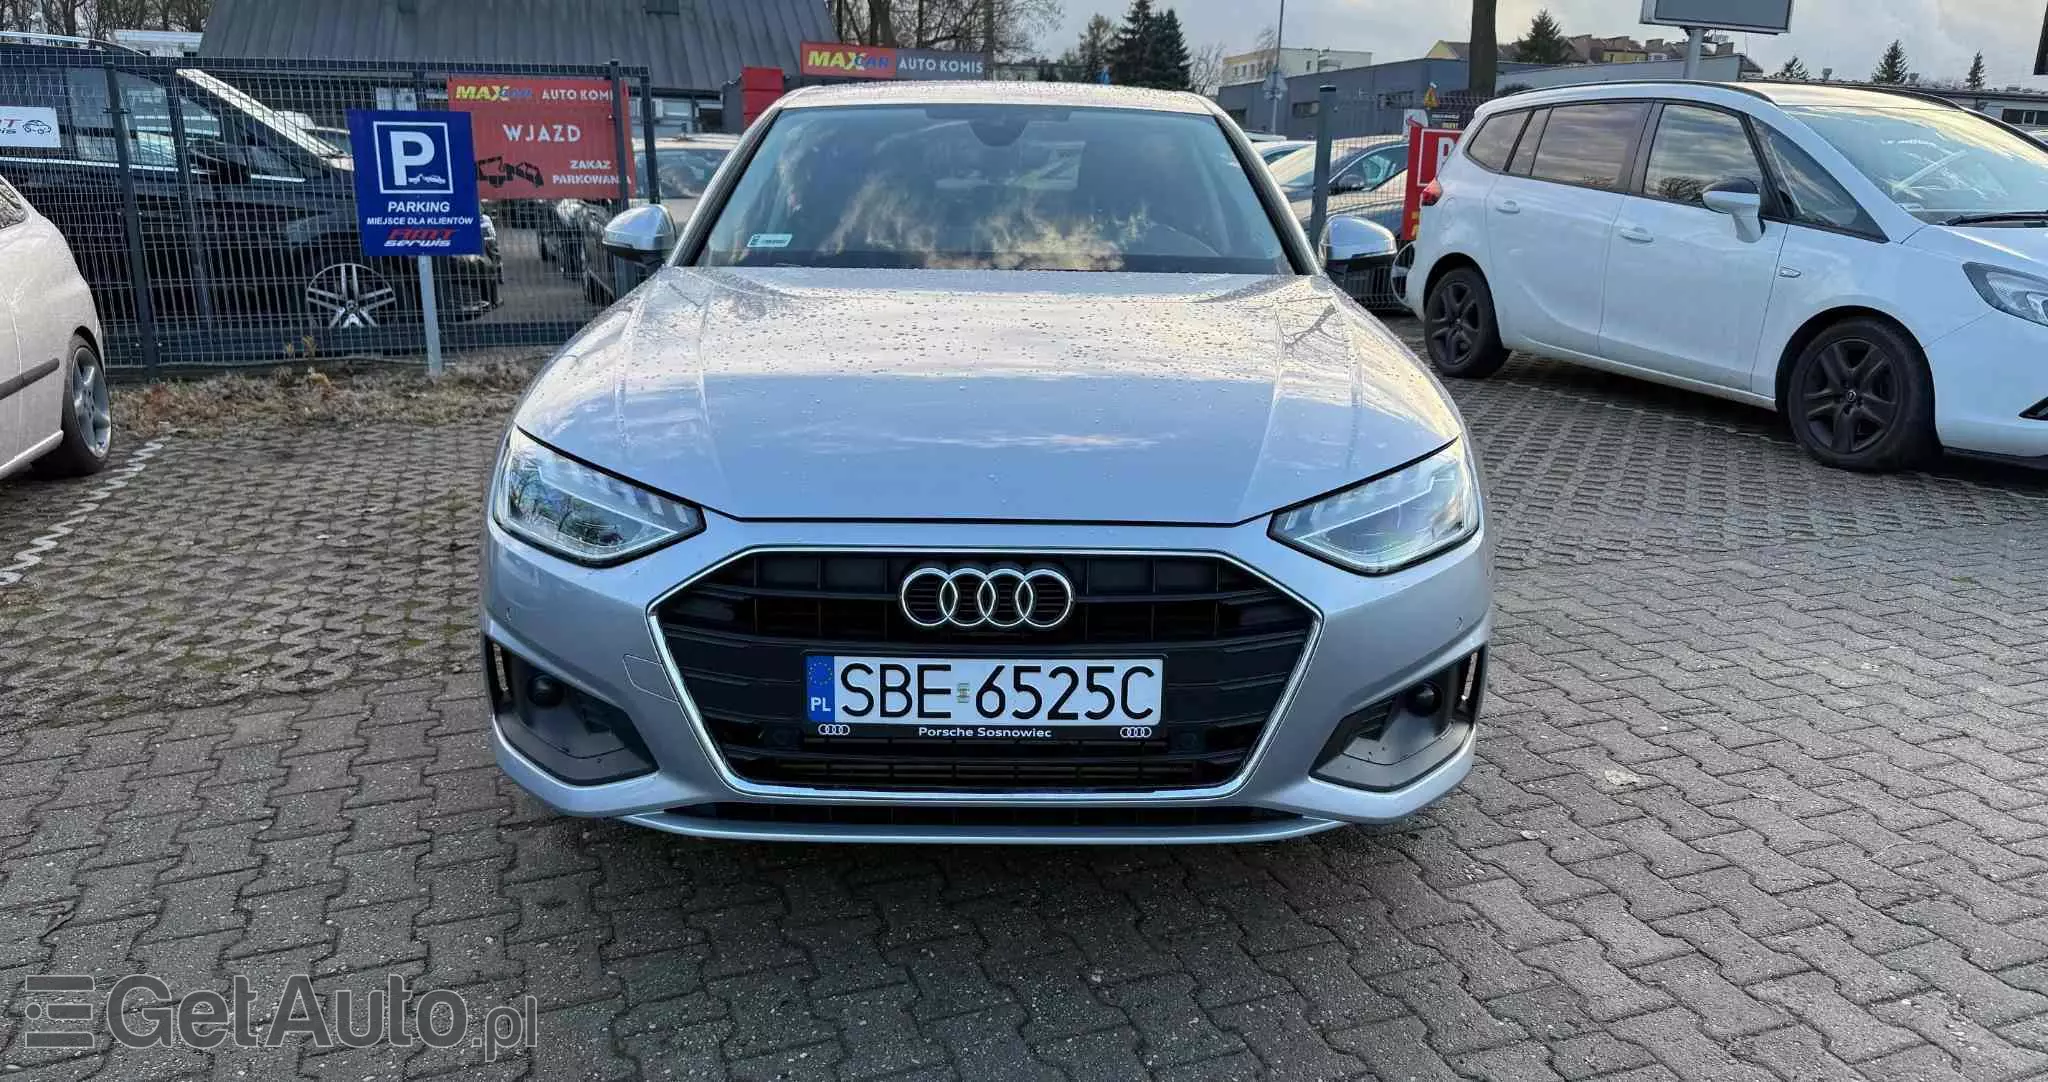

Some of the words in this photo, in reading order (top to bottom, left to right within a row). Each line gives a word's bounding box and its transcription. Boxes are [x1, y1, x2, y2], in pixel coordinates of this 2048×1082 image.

[900, 57, 937, 72] AUTO
[940, 59, 984, 73] KOMIS
[541, 88, 578, 101] AUTO
[581, 88, 614, 101] KOMI
[502, 123, 582, 143] WJAZD
[389, 130, 436, 186] P
[569, 160, 612, 169] ZAKAZ
[552, 174, 632, 186] PARKOWAN
[387, 201, 451, 213] PARKING
[366, 216, 405, 225] MIEJSCE
[407, 216, 426, 225] DLA
[427, 215, 473, 225] KLIENTÓW
[384, 238, 452, 247] serwis
[840, 662, 952, 719] SBE
[975, 664, 1156, 721] 6525C
[809, 696, 831, 713] PL
[918, 727, 974, 737] Porsche
[977, 727, 1052, 738] Sosnowiec
